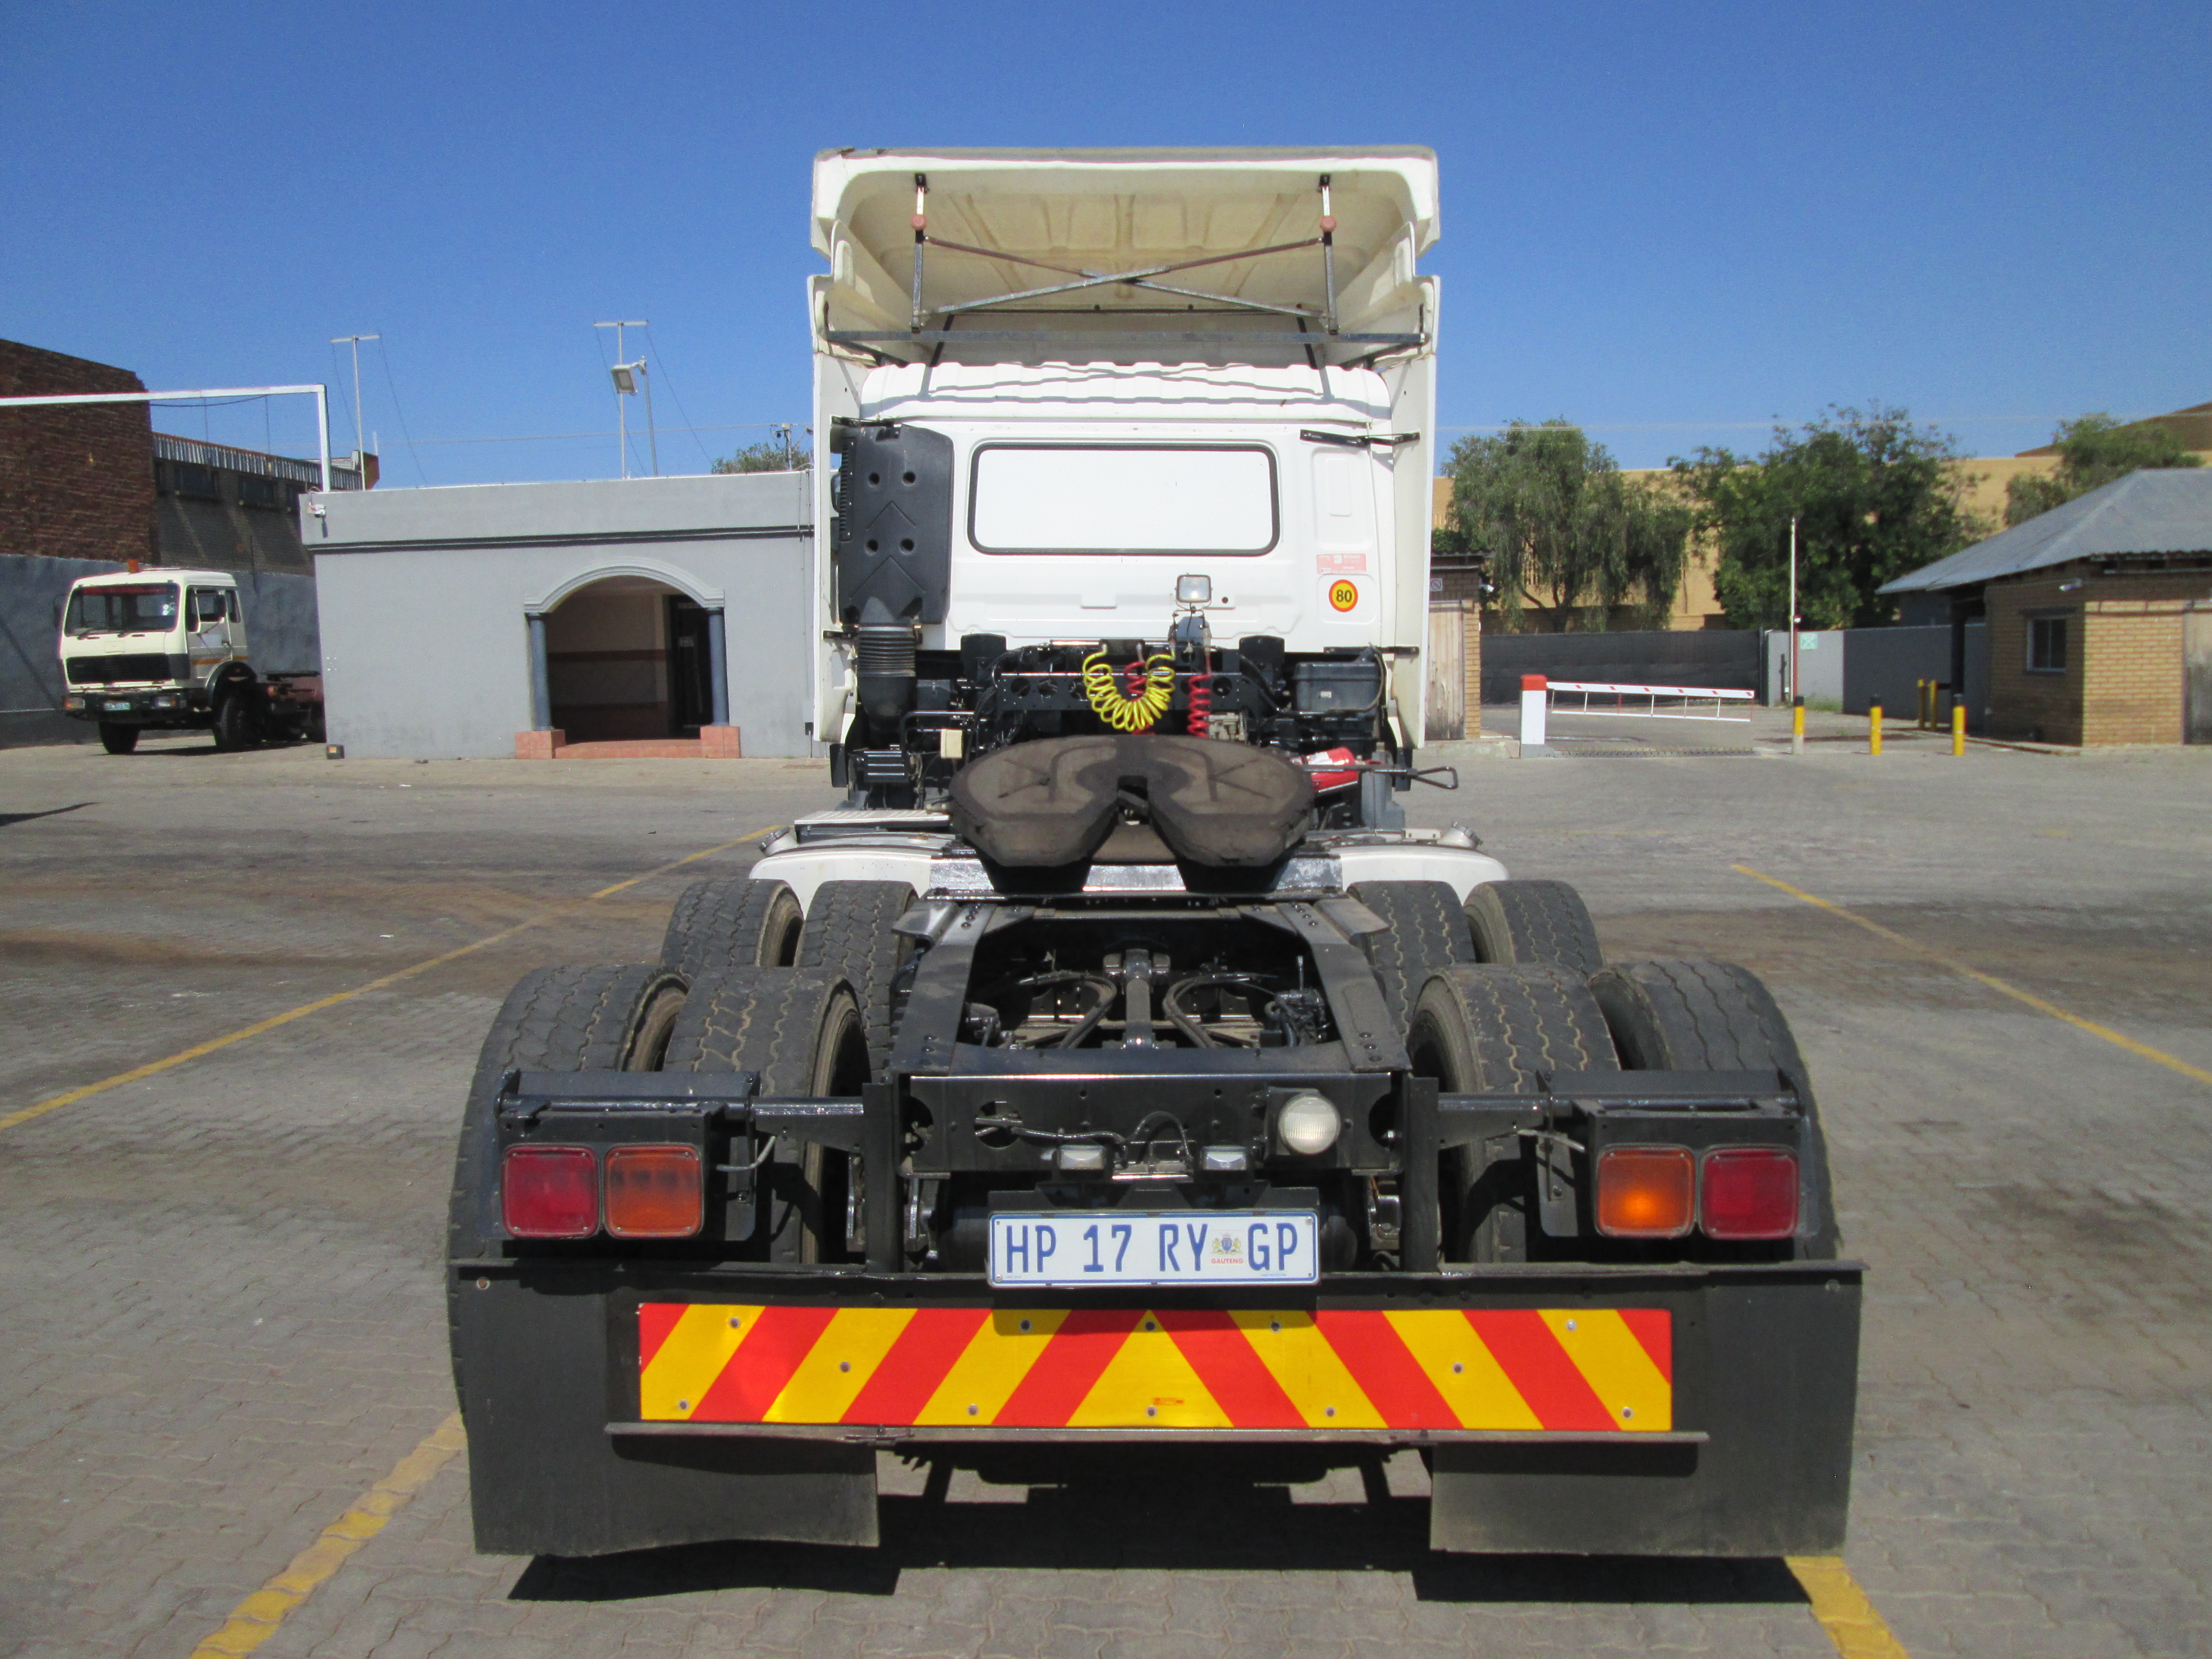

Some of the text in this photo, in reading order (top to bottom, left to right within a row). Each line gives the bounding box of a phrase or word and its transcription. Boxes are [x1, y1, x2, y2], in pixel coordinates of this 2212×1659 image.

[1336, 589, 1352, 602] 80
[1006, 1223, 1298, 1273] HP 17 RY GP
